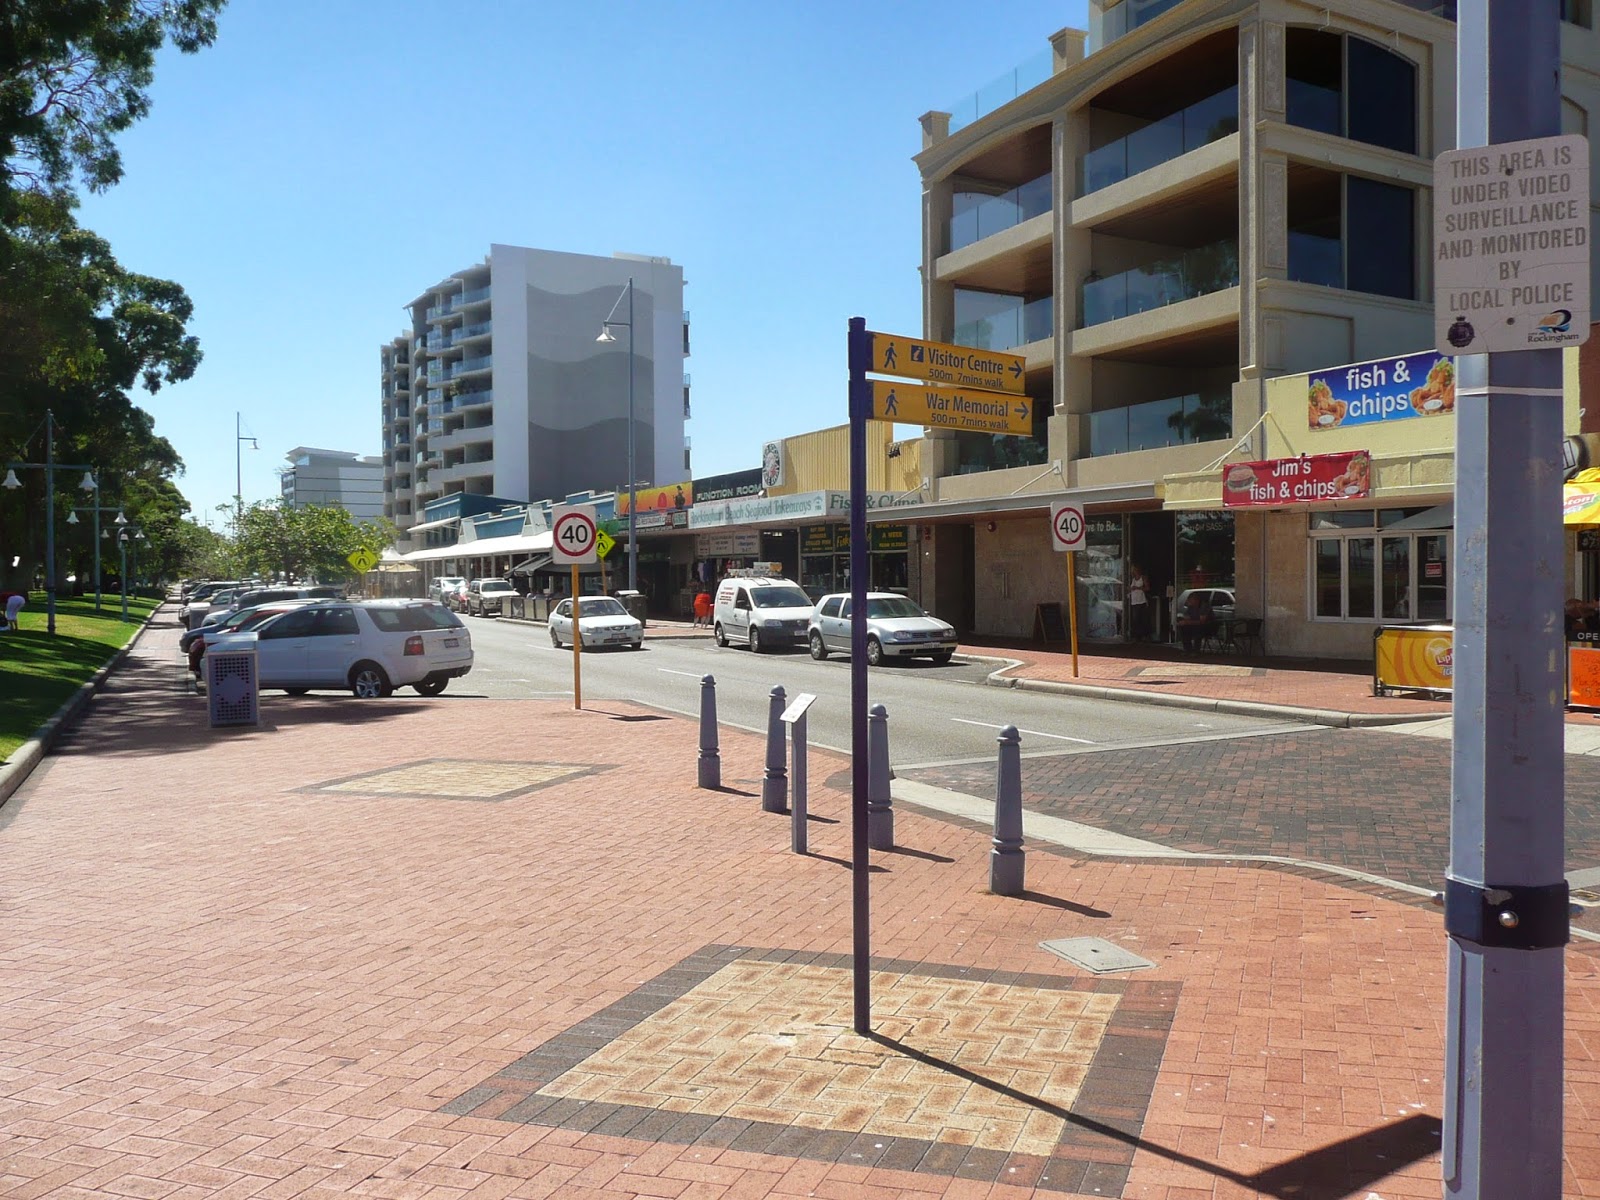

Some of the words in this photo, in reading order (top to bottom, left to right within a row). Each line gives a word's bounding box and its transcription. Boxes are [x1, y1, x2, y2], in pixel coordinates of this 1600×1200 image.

[1451, 158, 1489, 178] THIS
[1499, 149, 1545, 172] AREA
[1554, 146, 1572, 166] IS
[1451, 181, 1509, 205] UNDER
[1518, 173, 1571, 198] VIDEO
[1445, 200, 1578, 233] SURVEILLANCE
[1438, 239, 1473, 260] AND
[1481, 227, 1586, 256] MONITORED
[1499, 260, 1521, 280] BY
[1450, 289, 1504, 312] LOCAL
[1511, 283, 1573, 306] POLICE
[1528, 333, 1579, 343] Rockingham
[928, 347, 966, 369] Visitor
[967, 354, 1004, 375] Centre
[928, 369, 953, 381] 500m
[957, 371, 983, 385] 7mins
[984, 378, 1004, 389] walk
[1346, 365, 1385, 391] fish
[1393, 360, 1411, 383] &
[926, 392, 950, 411] War
[953, 396, 1009, 418] Memorial
[1349, 393, 1409, 419] chips
[961, 415, 987, 428] 7mins
[988, 419, 1009, 430] walk
[1272, 459, 1312, 478] Jim's
[697, 488, 734, 502] FUNCTION
[736, 484, 762, 496] ROOM
[1250, 482, 1276, 500] fish
[1280, 481, 1291, 498] &
[1294, 479, 1335, 500] chips
[690, 508, 724, 525] Rockingham
[725, 503, 744, 521] Beach
[745, 501, 772, 520] Seafood
[774, 498, 812, 515] Takeaways
[830, 494, 851, 509] Fis
[866, 494, 876, 508] &
[561, 524, 588, 544] 40
[1059, 517, 1079, 534] 40
[1577, 632, 1600, 641] OPE
